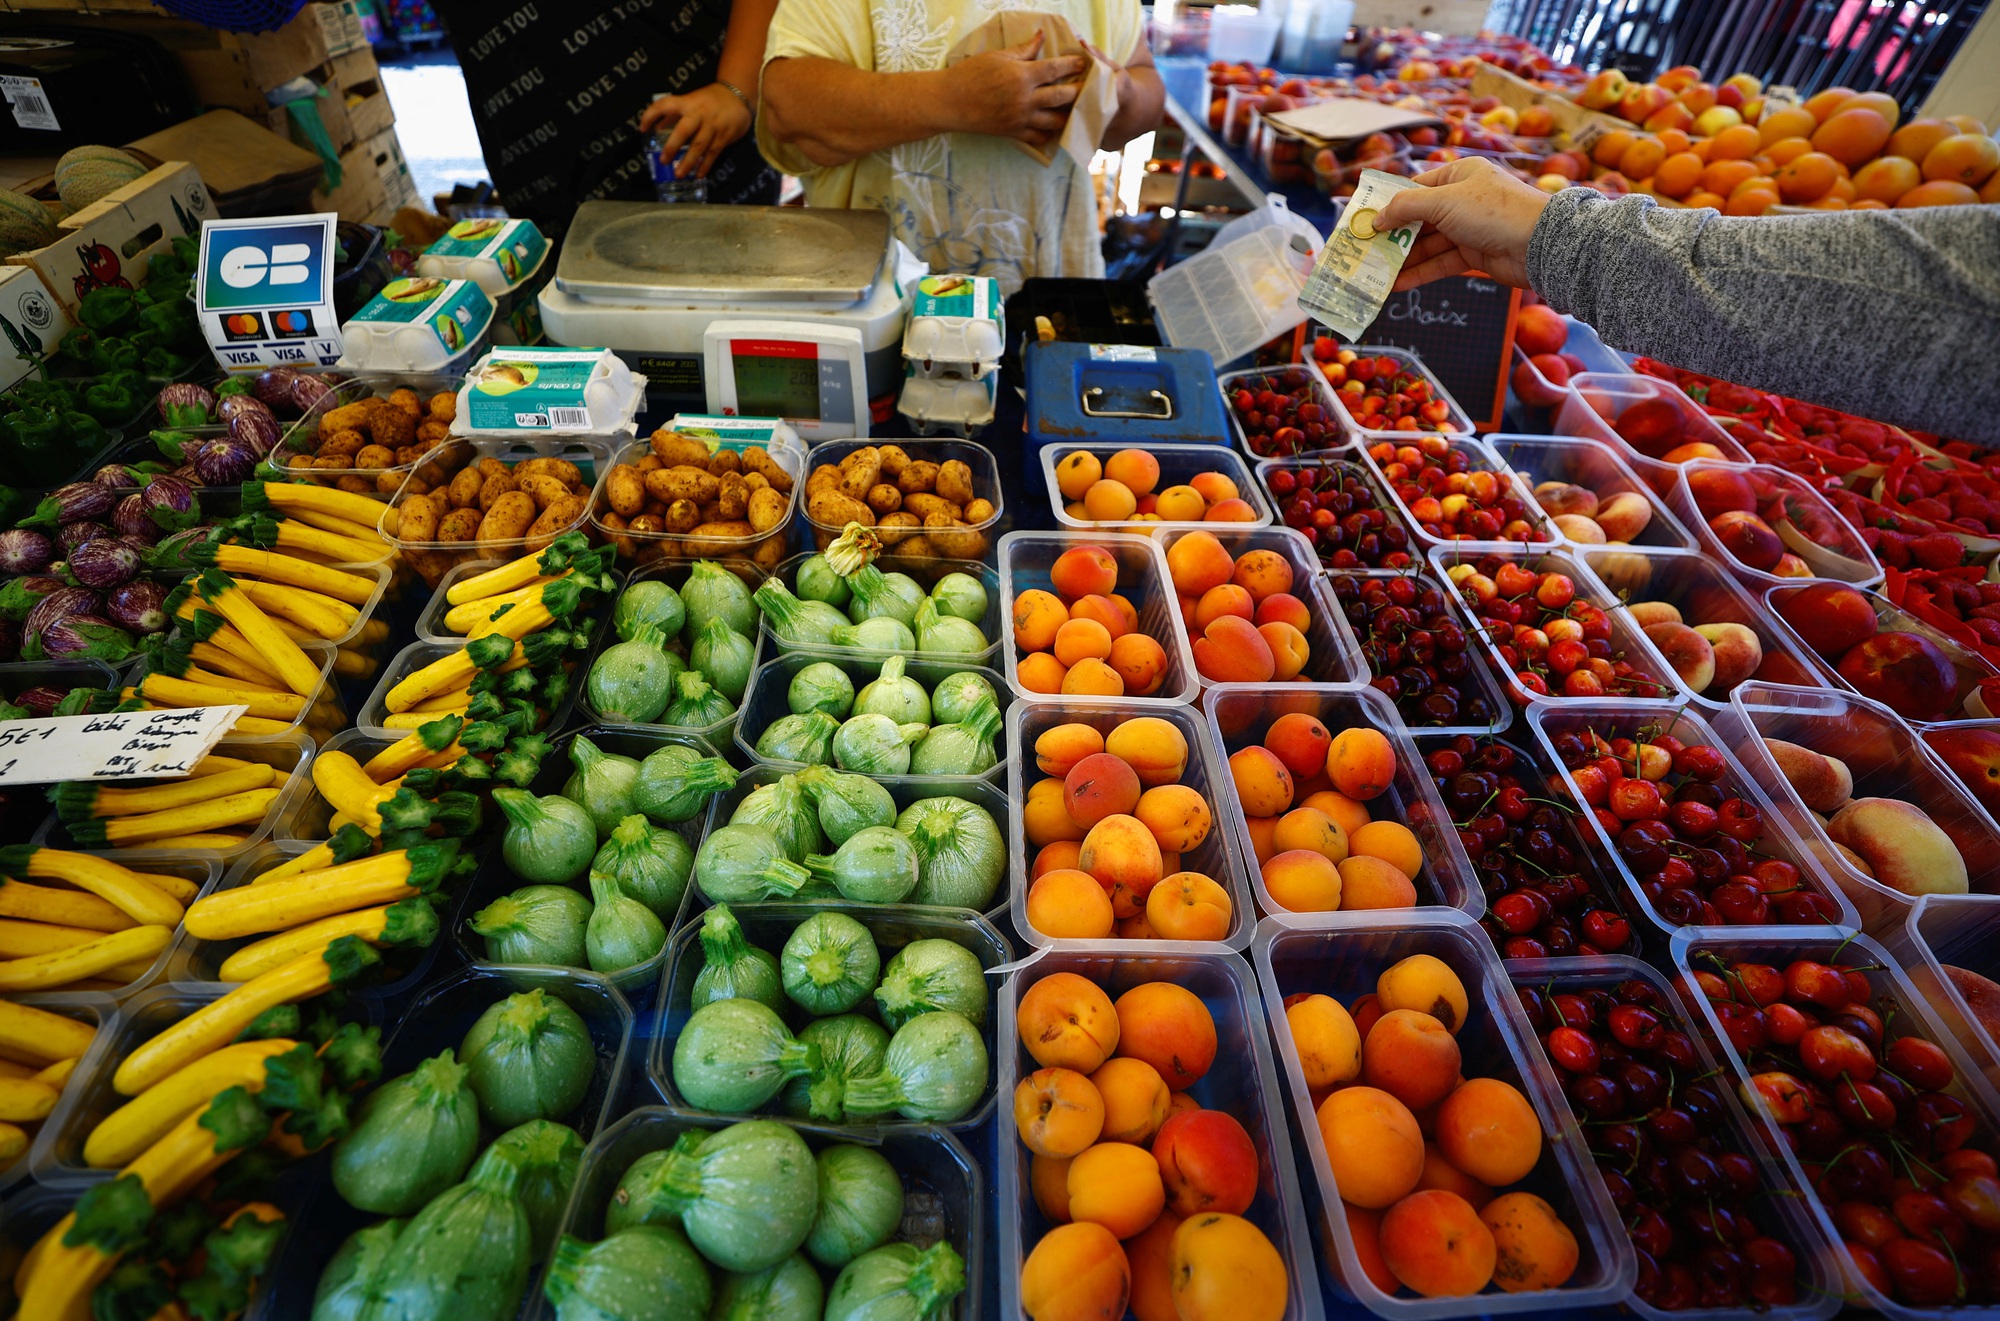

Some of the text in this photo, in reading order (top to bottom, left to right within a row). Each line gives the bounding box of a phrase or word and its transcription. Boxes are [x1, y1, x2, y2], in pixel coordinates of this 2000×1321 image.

[468, 2, 540, 61] LOVE YOU
[561, 13, 612, 55] LOVE
[510, 66, 545, 97] YOU
[565, 47, 649, 115] LOVE YOU
[668, 52, 707, 89] LOVE
[526, 120, 559, 148] YOU
[579, 127, 628, 161] LOVE
[1387, 228, 1413, 249] 5
[220, 243, 311, 289] CB
[1388, 288, 1469, 327] choix
[224, 352, 261, 364] VISA
[272, 348, 306, 361] VISA
[318, 343, 332, 355] V
[822, 365, 833, 373] kg
[537, 382, 582, 390] 6 œufs
[822, 381, 841, 389] €/kg
